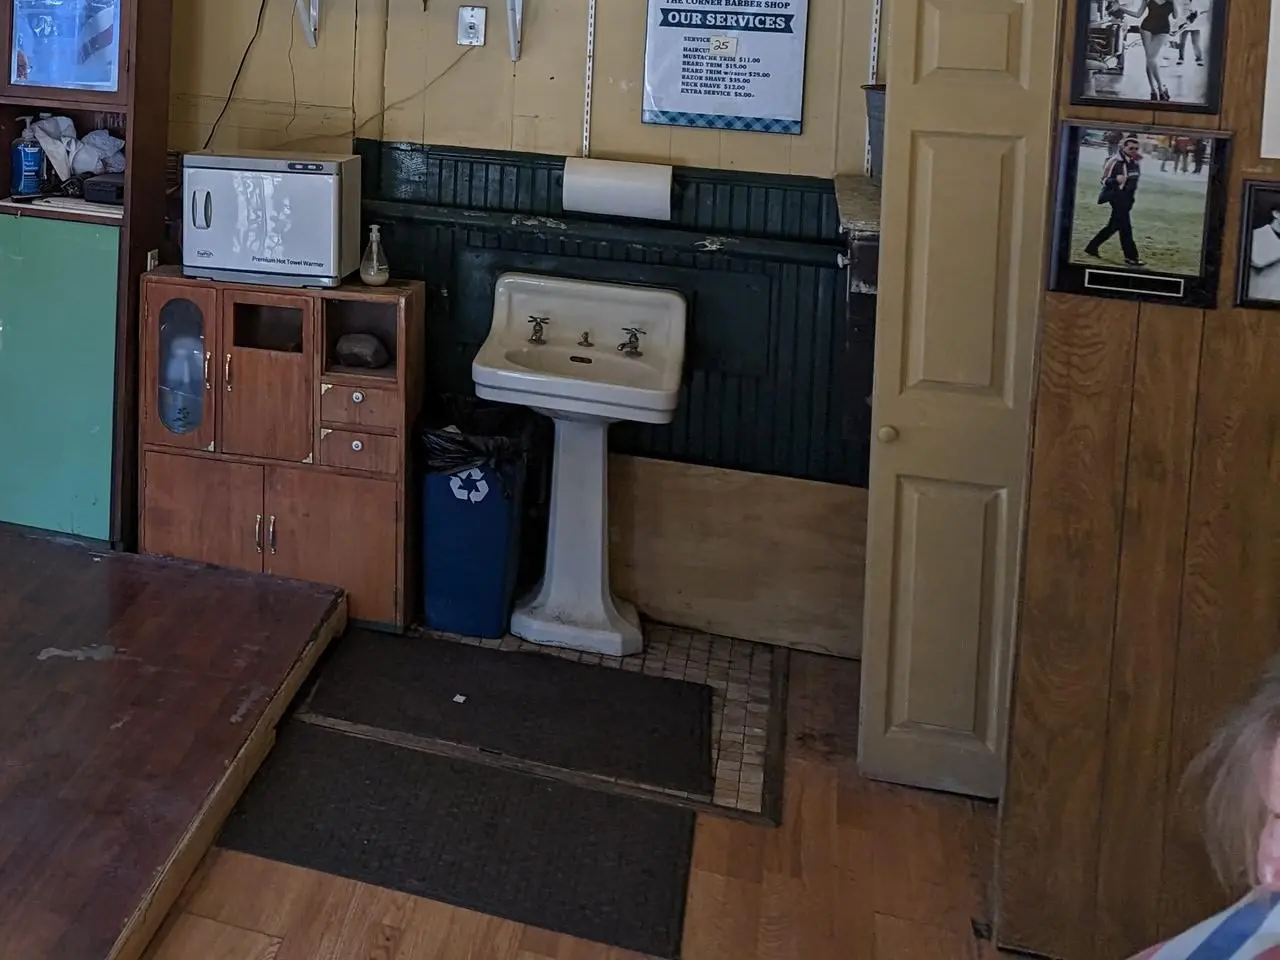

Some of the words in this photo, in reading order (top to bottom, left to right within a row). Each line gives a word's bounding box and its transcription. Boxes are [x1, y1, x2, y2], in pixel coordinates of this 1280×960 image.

[725, 0, 762, 8] BARBER
[764, 1, 790, 9] SHOP
[667, 11, 702, 25] OUR
[705, 14, 786, 29] SERVICES
[252, 256, 276, 264] Premium
[303, 260, 324, 268] Warmer
